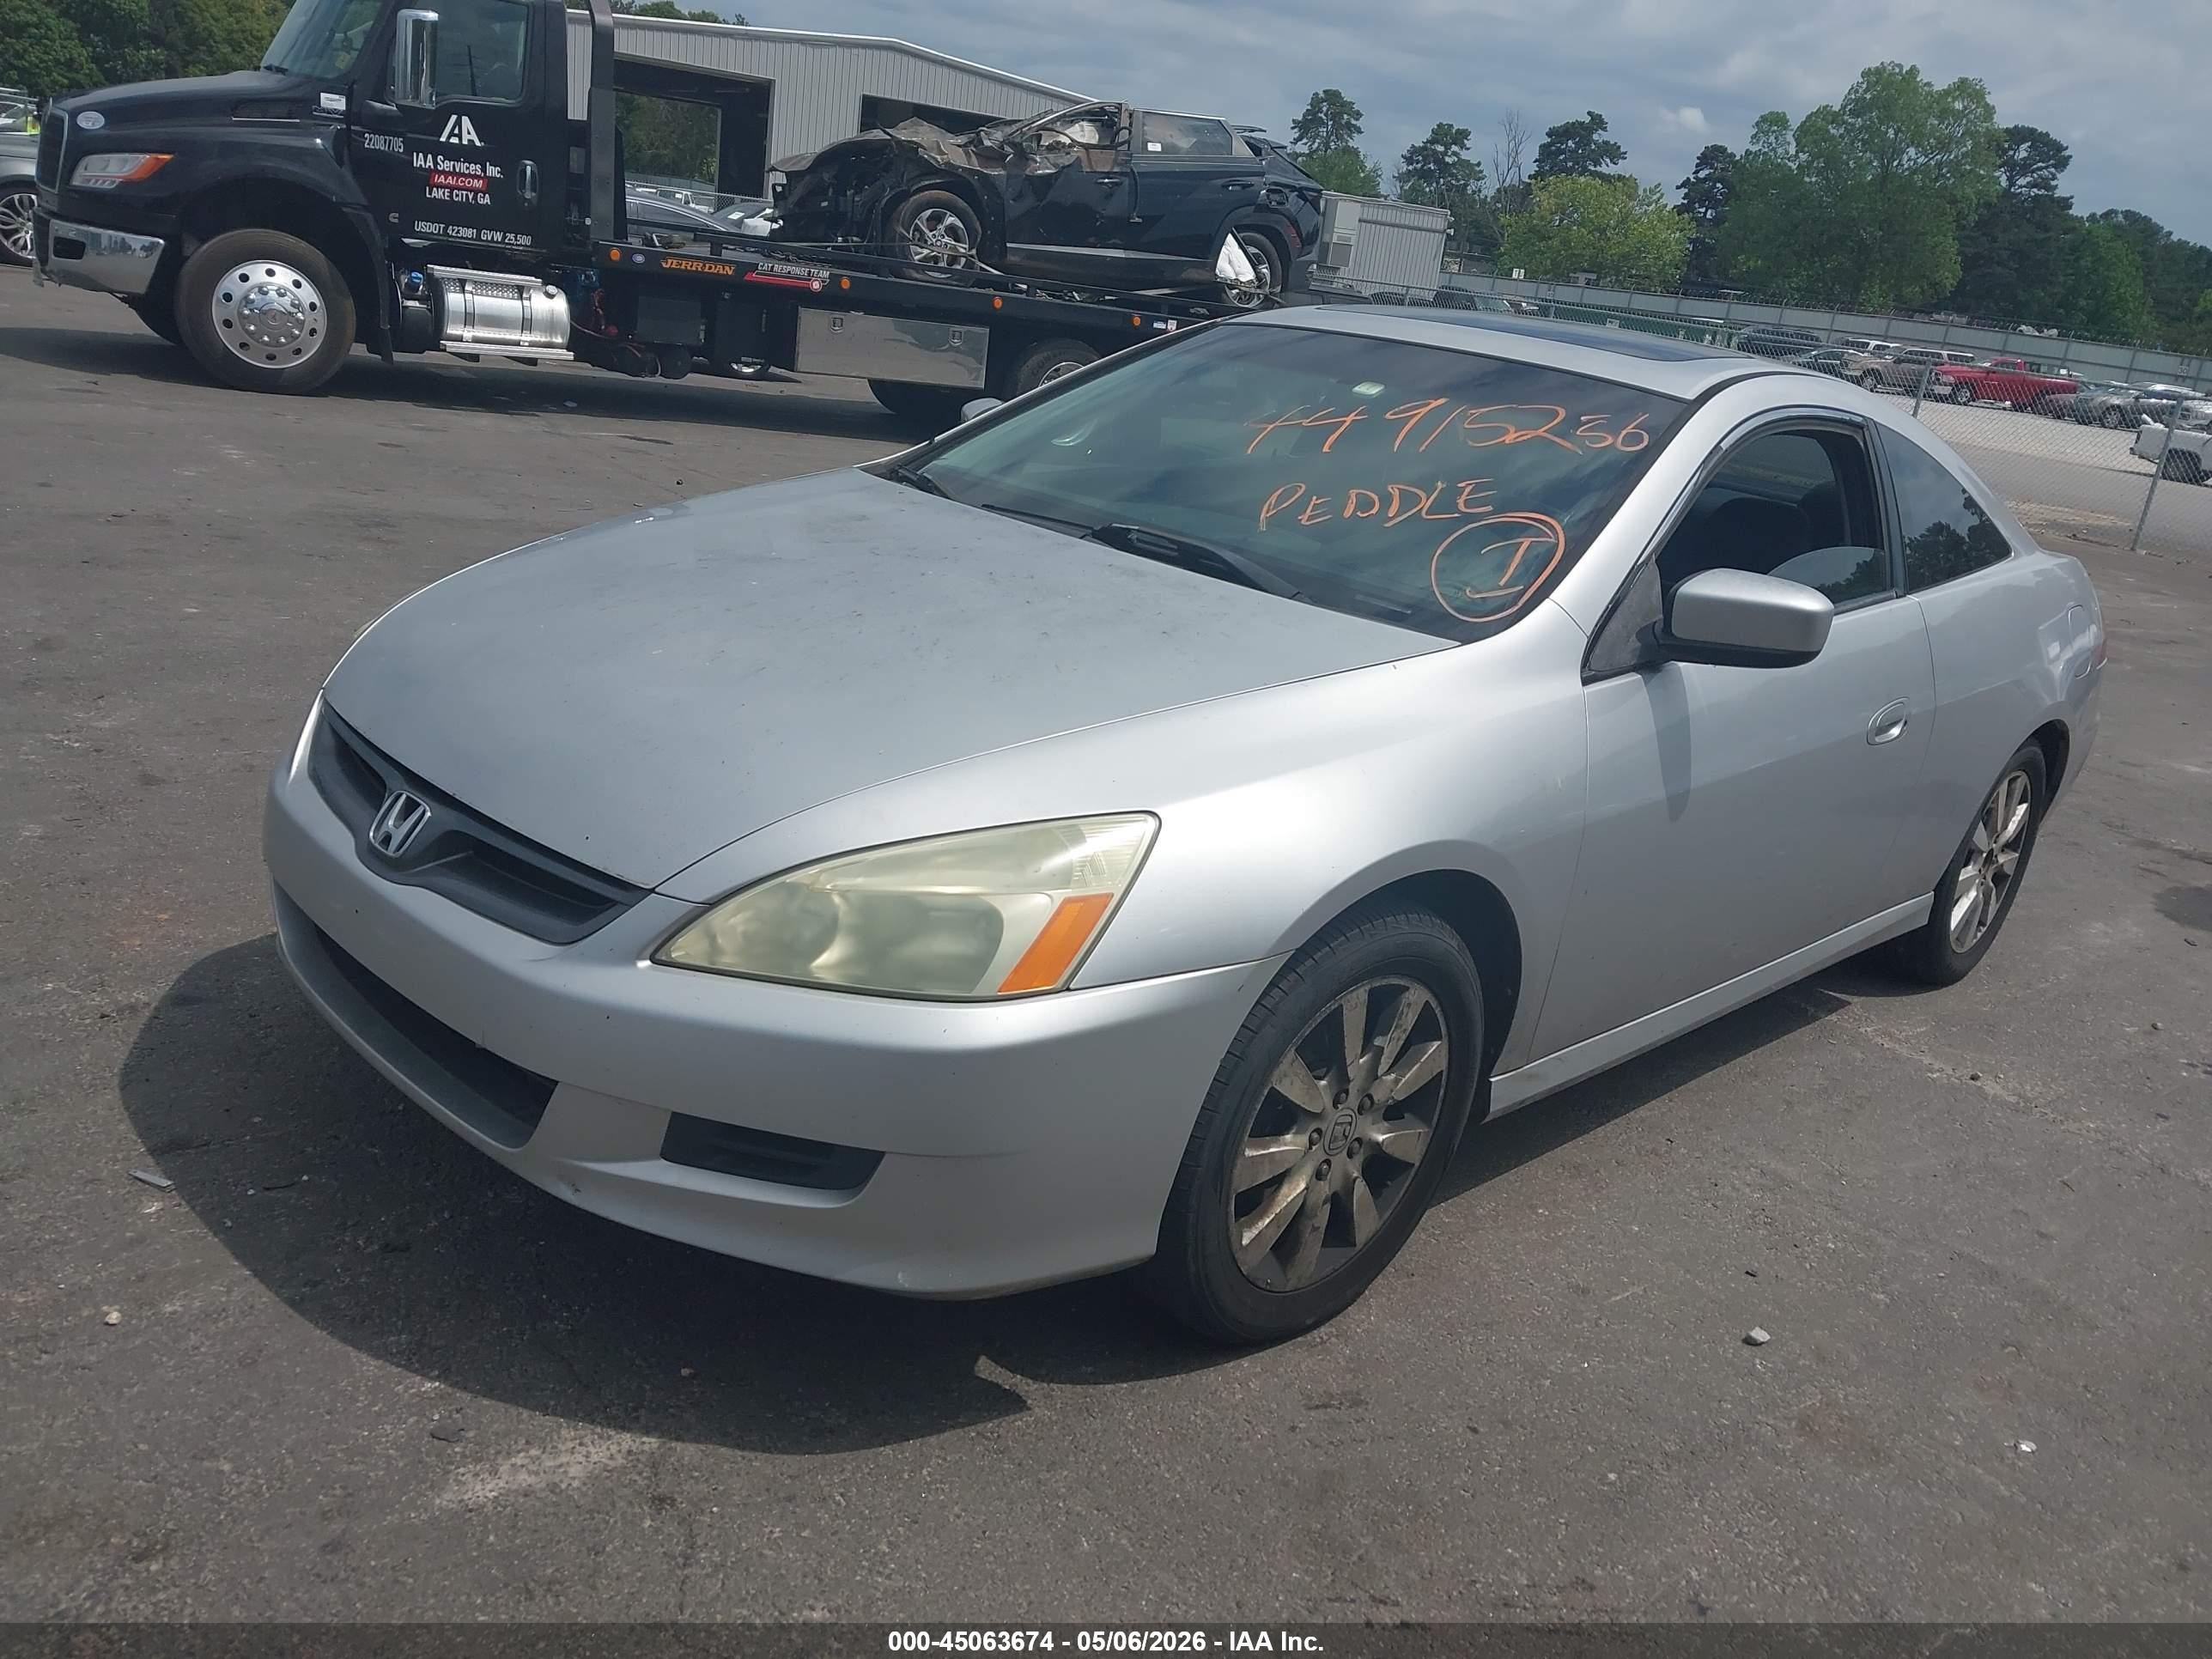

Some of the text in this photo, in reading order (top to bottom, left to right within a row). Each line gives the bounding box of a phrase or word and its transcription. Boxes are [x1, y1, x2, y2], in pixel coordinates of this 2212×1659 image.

[364, 133, 404, 152] 22087705
[412, 152, 504, 179] IAA Services, Inc.
[434, 173, 483, 188] IAAI.COM
[426, 185, 491, 205] LAKE CITY, GA
[414, 220, 532, 246] USDOT 423081 GVW 25,500
[757, 262, 830, 279] CAT RESPONSE TEAM
[1258, 477, 1499, 532] PEDDLE
